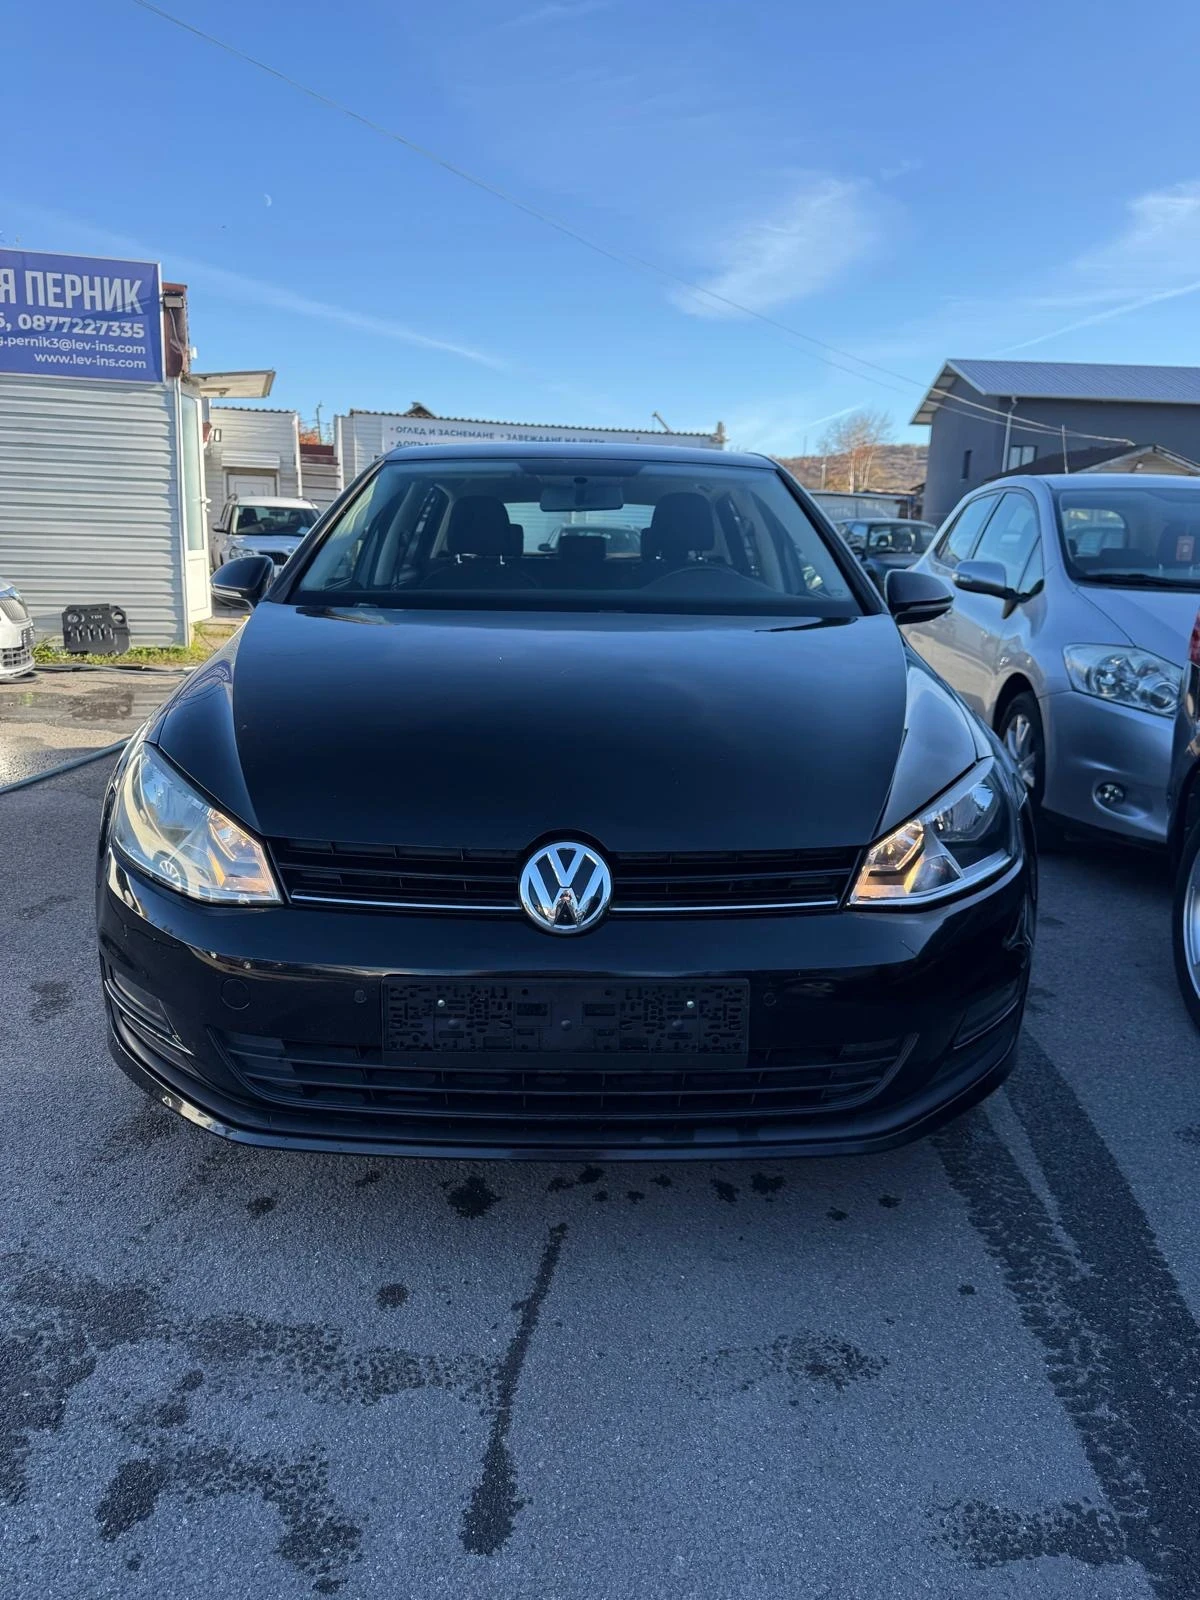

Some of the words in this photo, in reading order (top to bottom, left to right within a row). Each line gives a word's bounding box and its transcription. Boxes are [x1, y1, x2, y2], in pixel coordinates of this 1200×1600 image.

[0, 268, 17, 304] Я
[25, 270, 144, 314] ПЕРНИК
[18, 313, 145, 338] 0877227335
[34, 353, 147, 369] www.lev-ins.com
[395, 426, 426, 436] ОГЛЕД
[429, 428, 436, 436] И
[438, 429, 495, 440] ЗАСНЕМАНЕ
